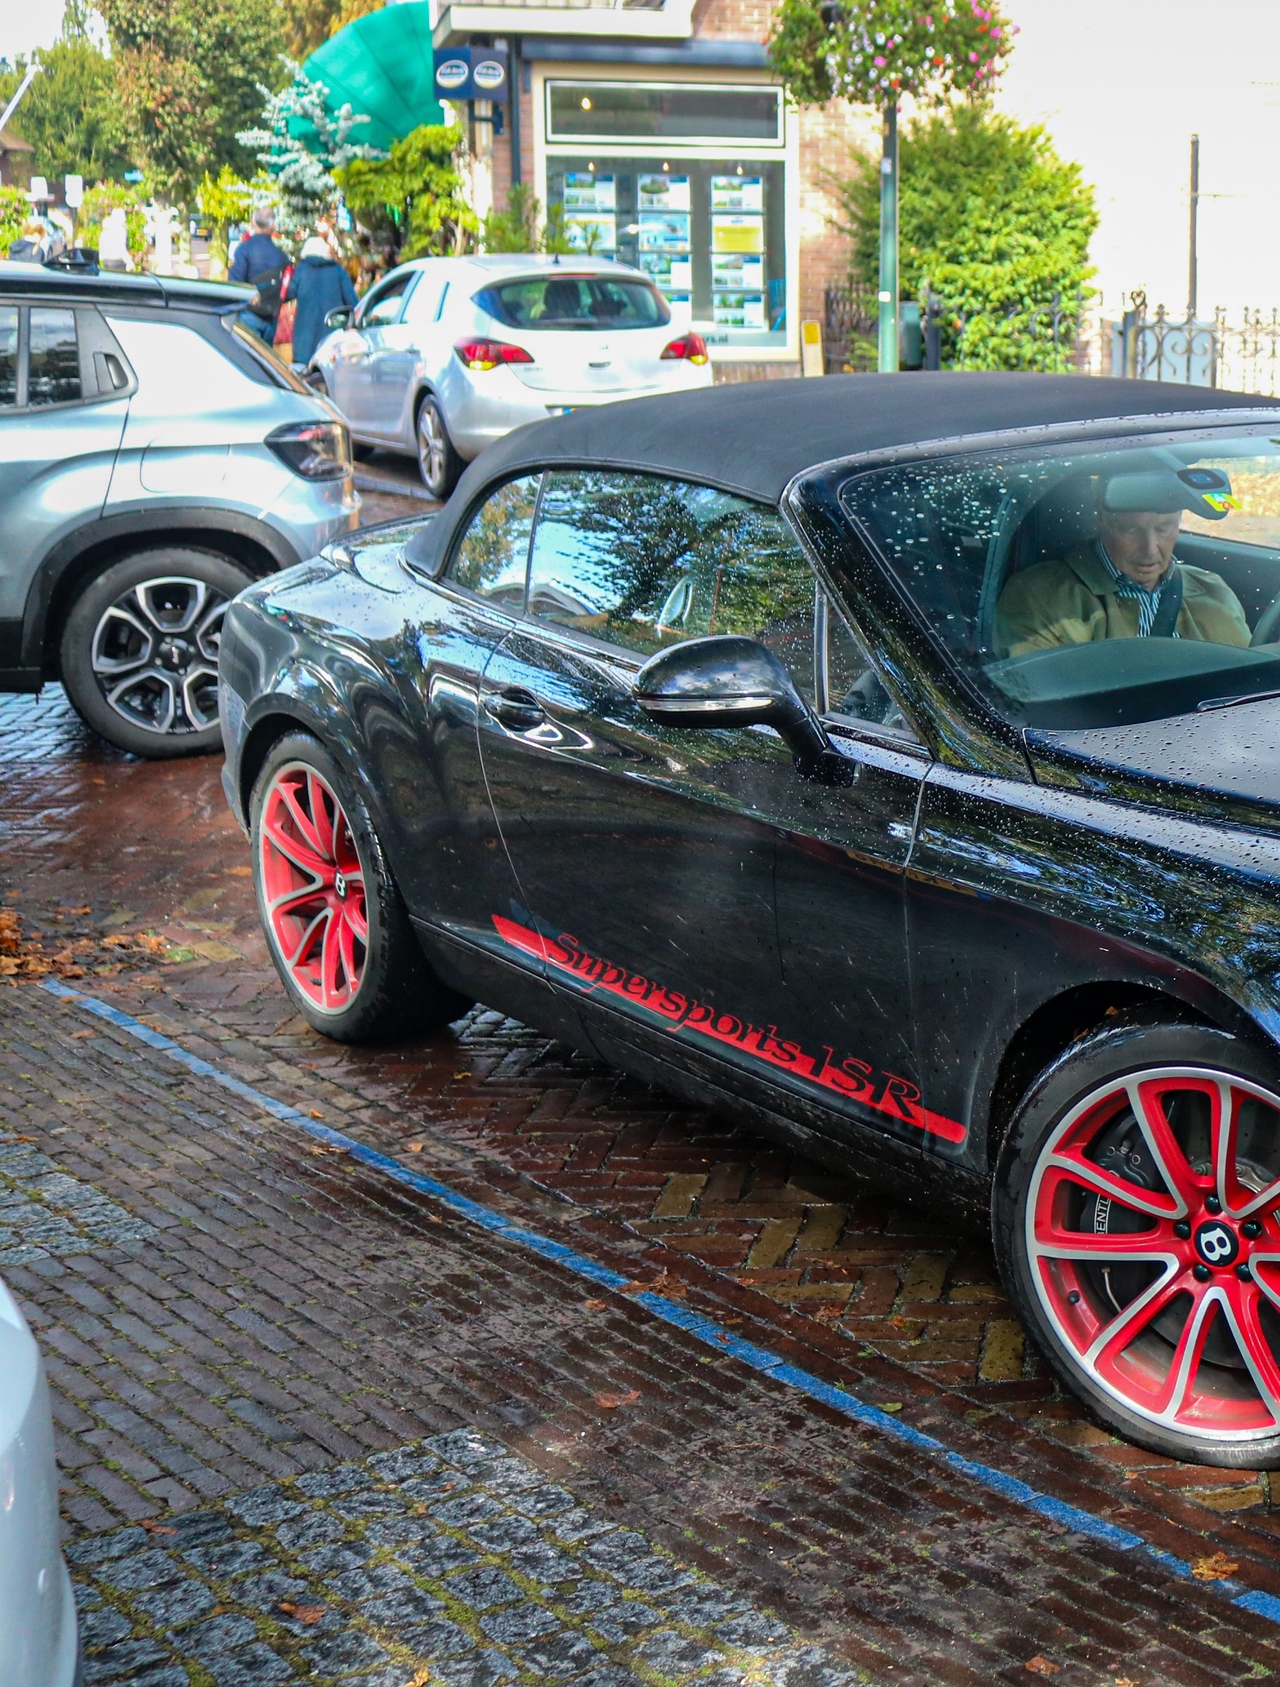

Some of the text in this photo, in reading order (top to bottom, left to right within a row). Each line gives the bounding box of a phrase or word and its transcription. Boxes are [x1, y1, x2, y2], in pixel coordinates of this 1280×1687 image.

[549, 932, 801, 1062] Supersports
[1096, 1198, 1109, 1234] ENTL
[1200, 1227, 1231, 1261] B
